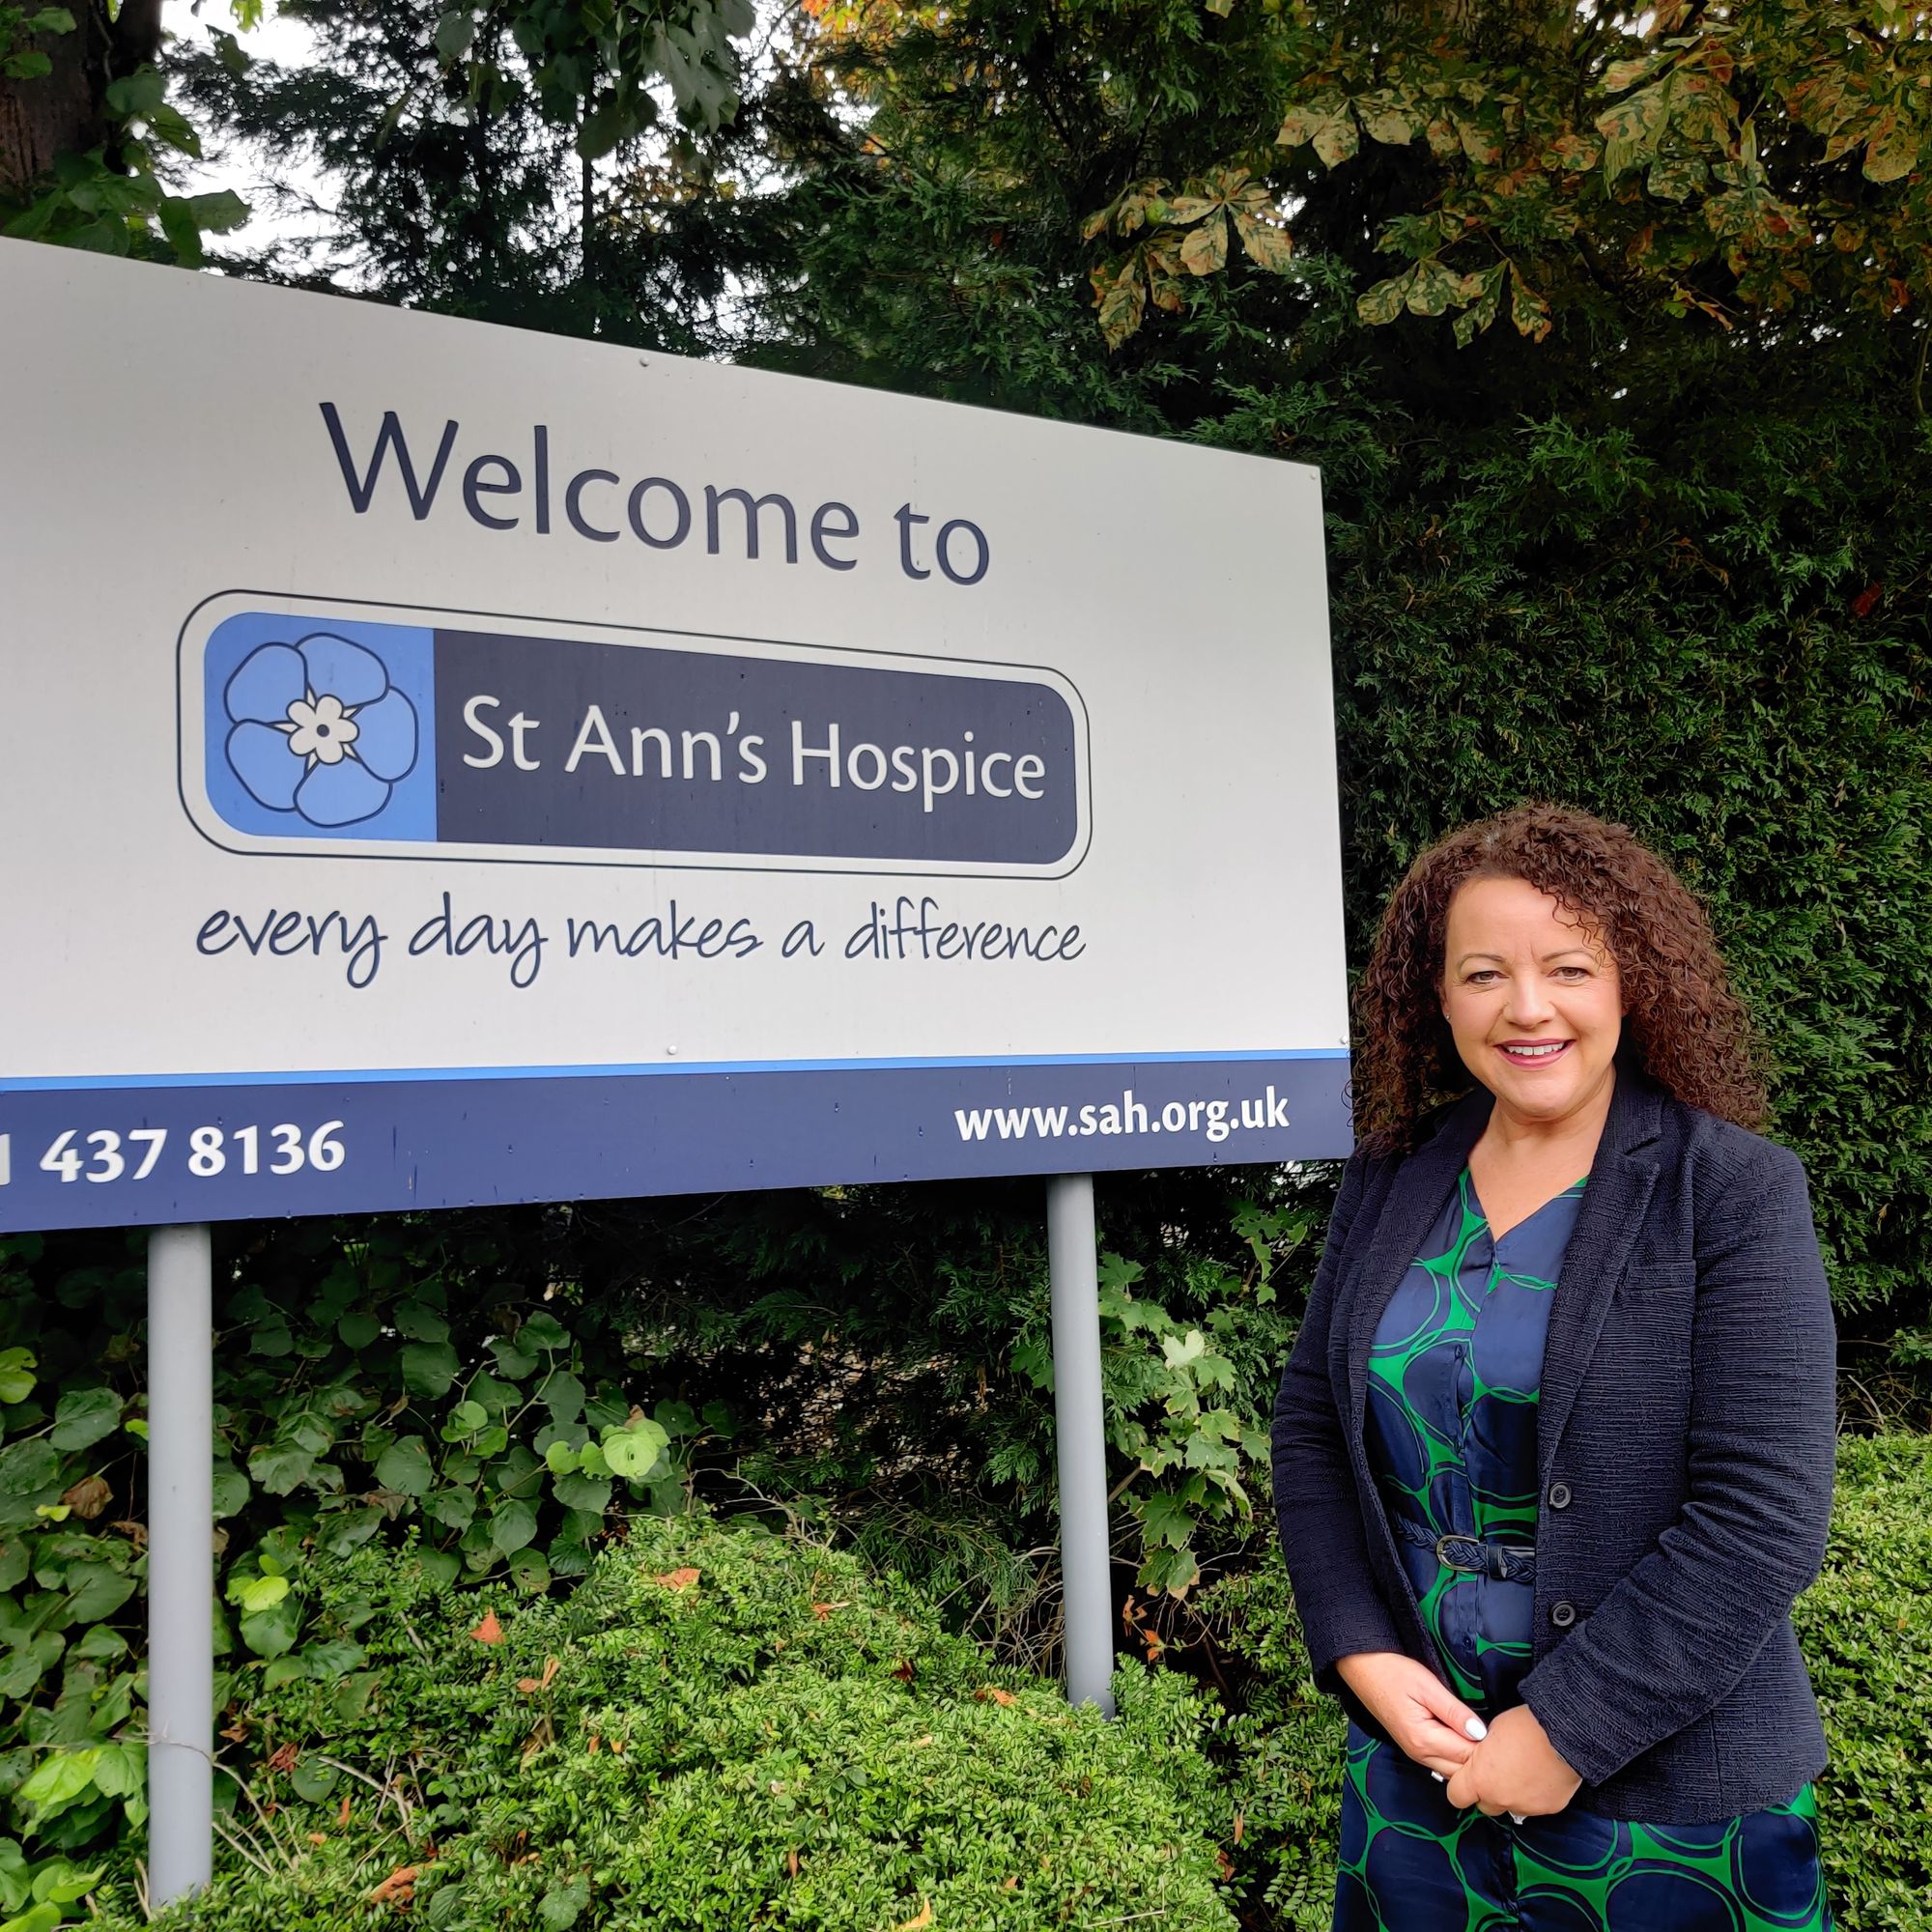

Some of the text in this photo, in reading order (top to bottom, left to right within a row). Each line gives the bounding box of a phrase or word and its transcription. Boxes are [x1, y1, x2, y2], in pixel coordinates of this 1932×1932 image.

[319, 402, 989, 585] Welcome to
[464, 696, 1044, 812] St Ann's Hospice
[197, 892, 1086, 988] every day makes a difference
[41, 1129, 167, 1182] 437
[188, 1121, 344, 1176] 8136
[954, 1086, 1289, 1142] www.sah.org.uk
